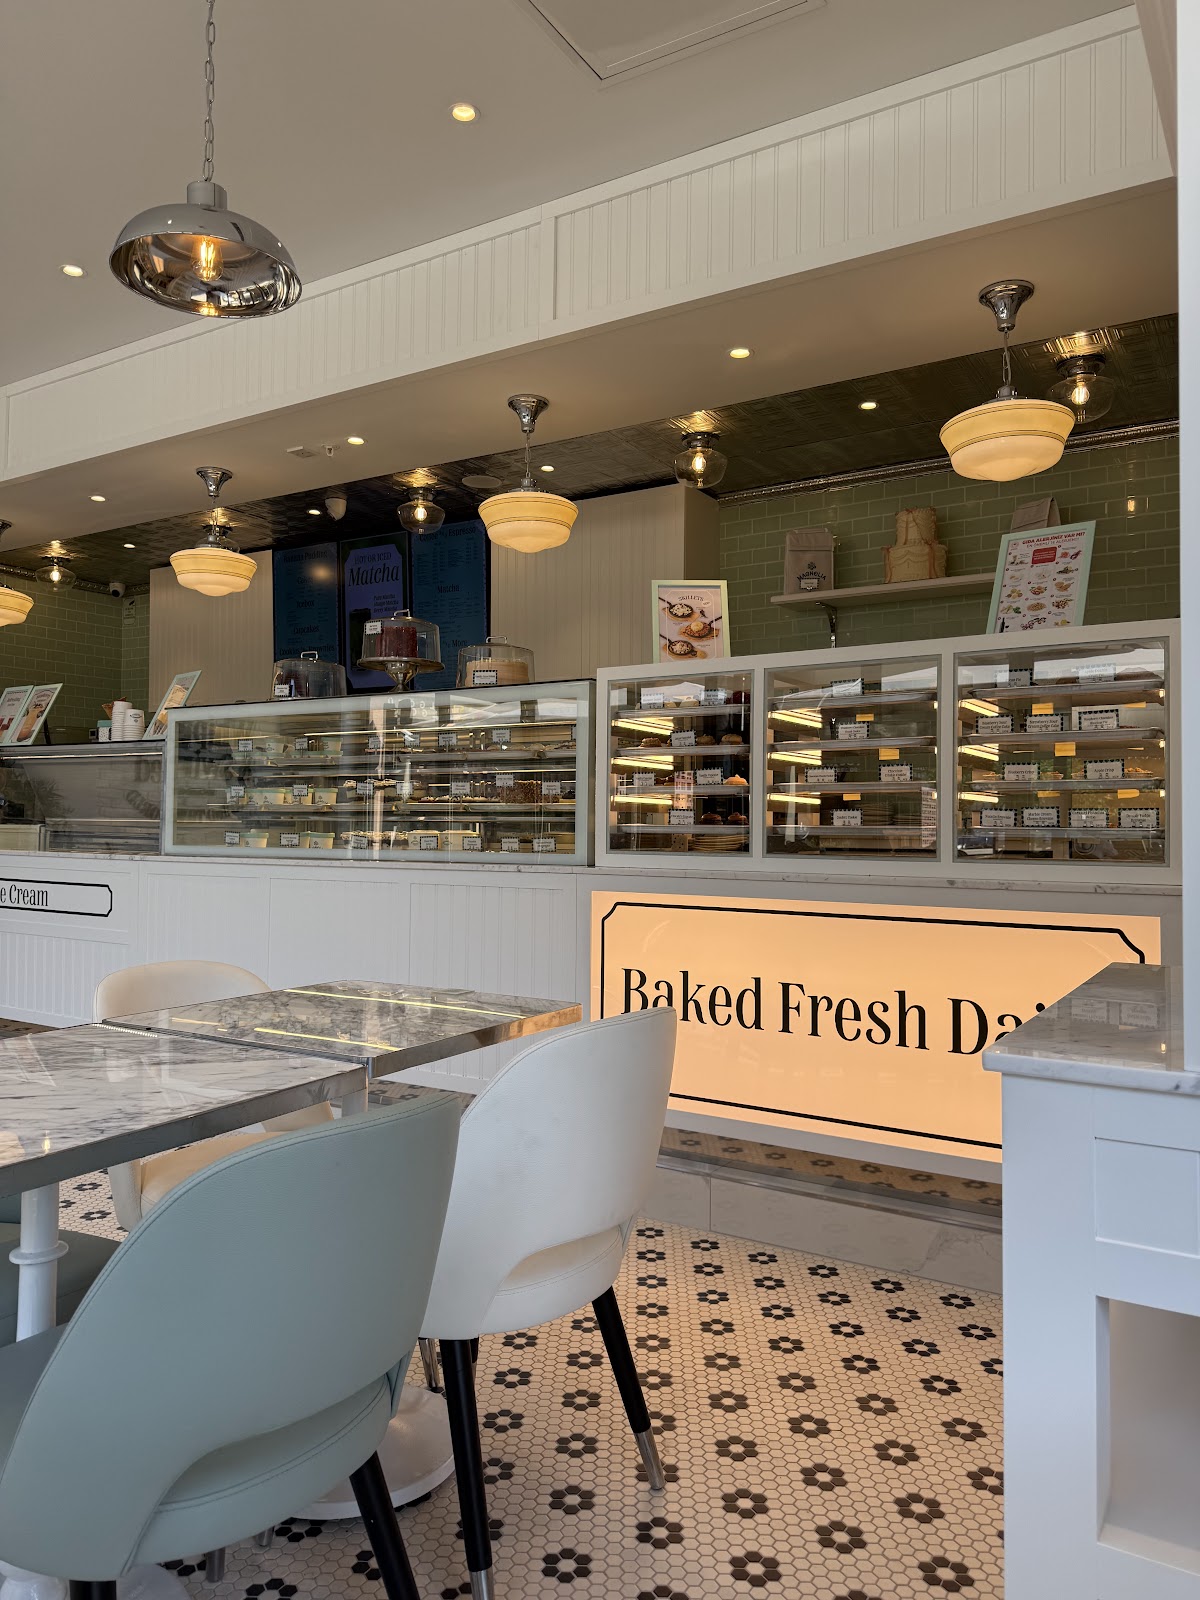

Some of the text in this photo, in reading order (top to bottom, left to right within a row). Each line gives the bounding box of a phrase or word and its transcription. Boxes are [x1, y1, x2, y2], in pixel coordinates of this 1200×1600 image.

[448, 526, 476, 537] Espresso
[305, 550, 328, 560] Pudding
[354, 551, 392, 565] HOT OR ICED
[348, 563, 400, 587] Matcha
[796, 570, 826, 581] MAGNOLIA
[437, 584, 460, 594] Matcha
[293, 624, 320, 635] Cupcakes
[452, 639, 467, 648] More
[9, 884, 48, 907] Cream
[621, 967, 1046, 1056] Baked Fresh Da
